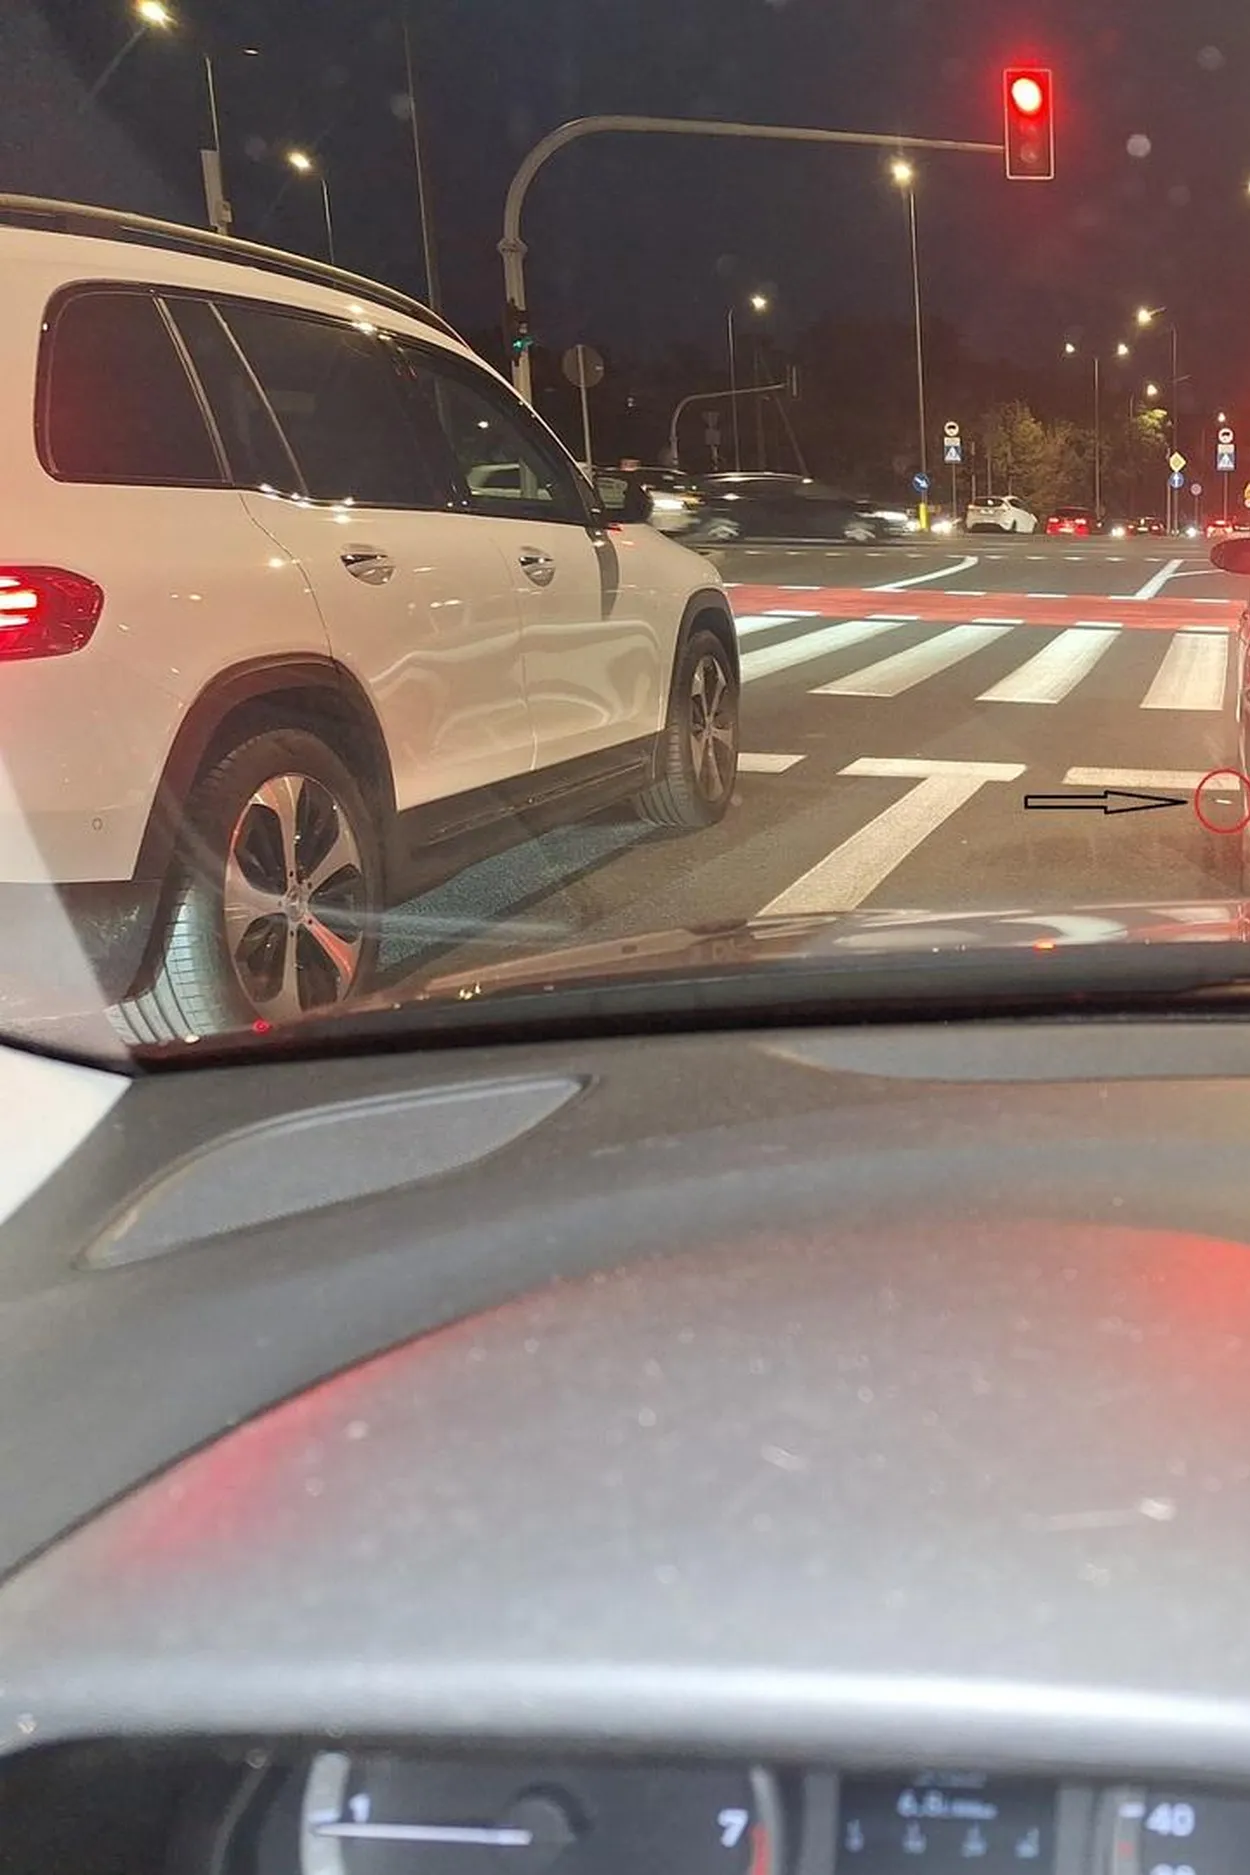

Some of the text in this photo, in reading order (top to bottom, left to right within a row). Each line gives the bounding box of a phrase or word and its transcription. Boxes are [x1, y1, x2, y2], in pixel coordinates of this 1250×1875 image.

[350, 1794, 371, 1823] 1
[1146, 1803, 1195, 1836] 40
[718, 1808, 748, 1847] 7
